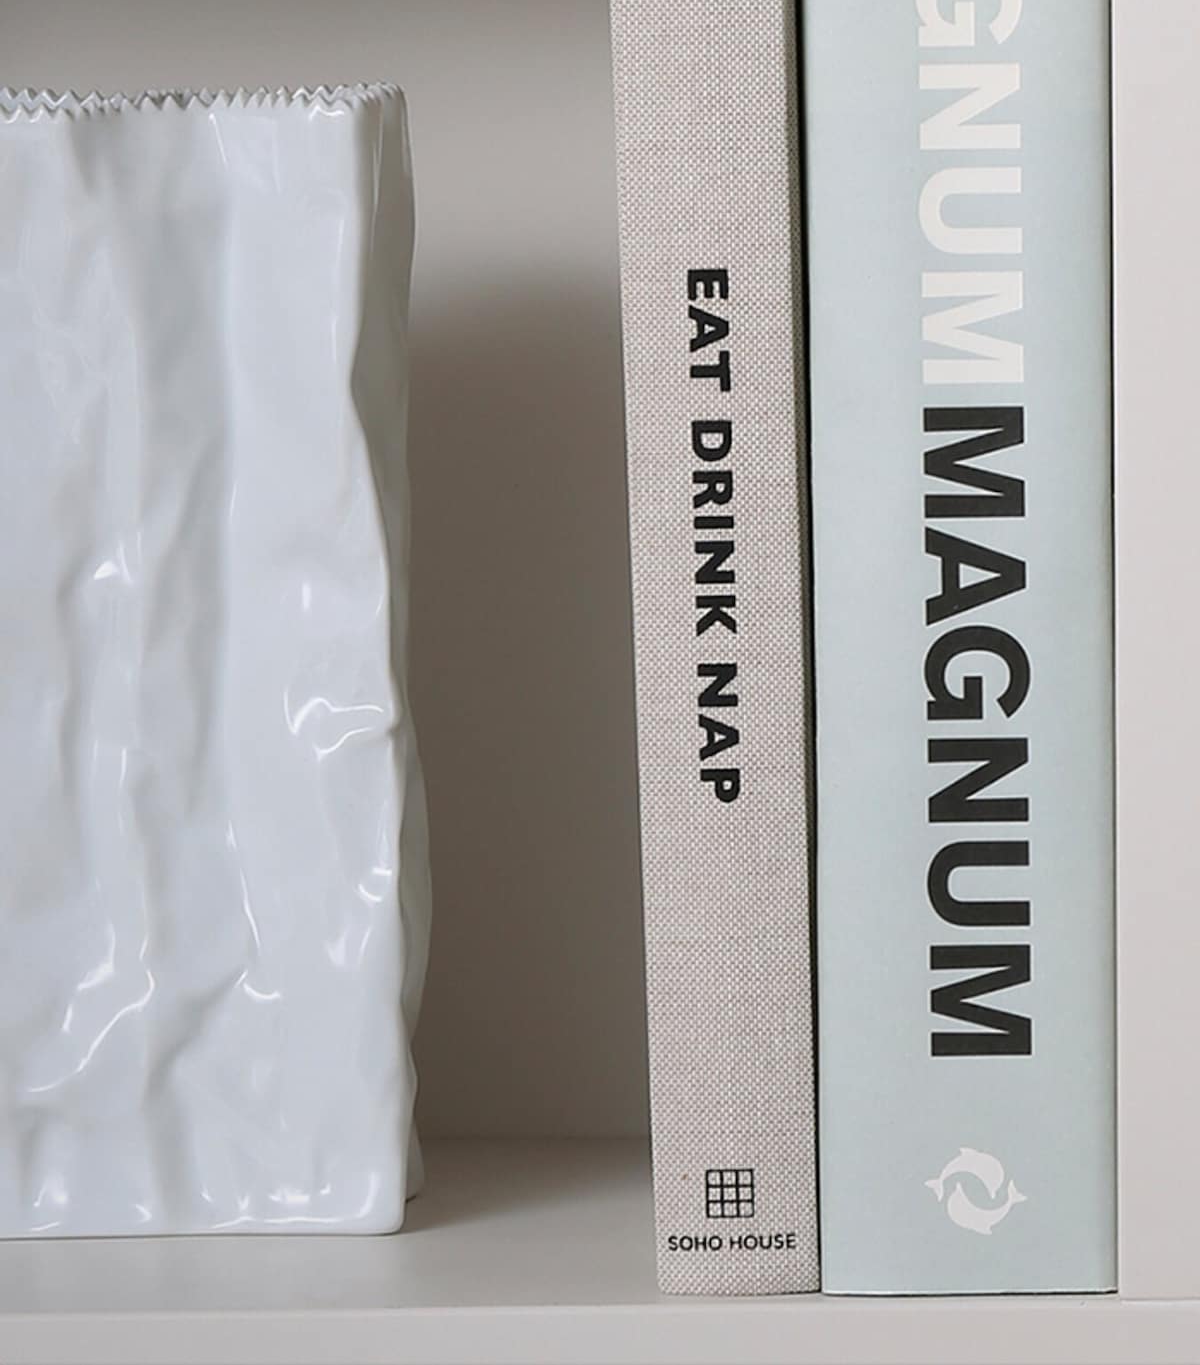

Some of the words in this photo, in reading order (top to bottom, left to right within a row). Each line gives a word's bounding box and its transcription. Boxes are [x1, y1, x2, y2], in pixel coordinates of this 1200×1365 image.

[686, 267, 732, 393] EAT
[690, 418, 738, 637] DRINK
[696, 661, 741, 804] NAP
[922, 405, 1033, 1058] MAGNUM
[667, 1234, 723, 1252] SOHO
[729, 1232, 797, 1251] HOUSE
